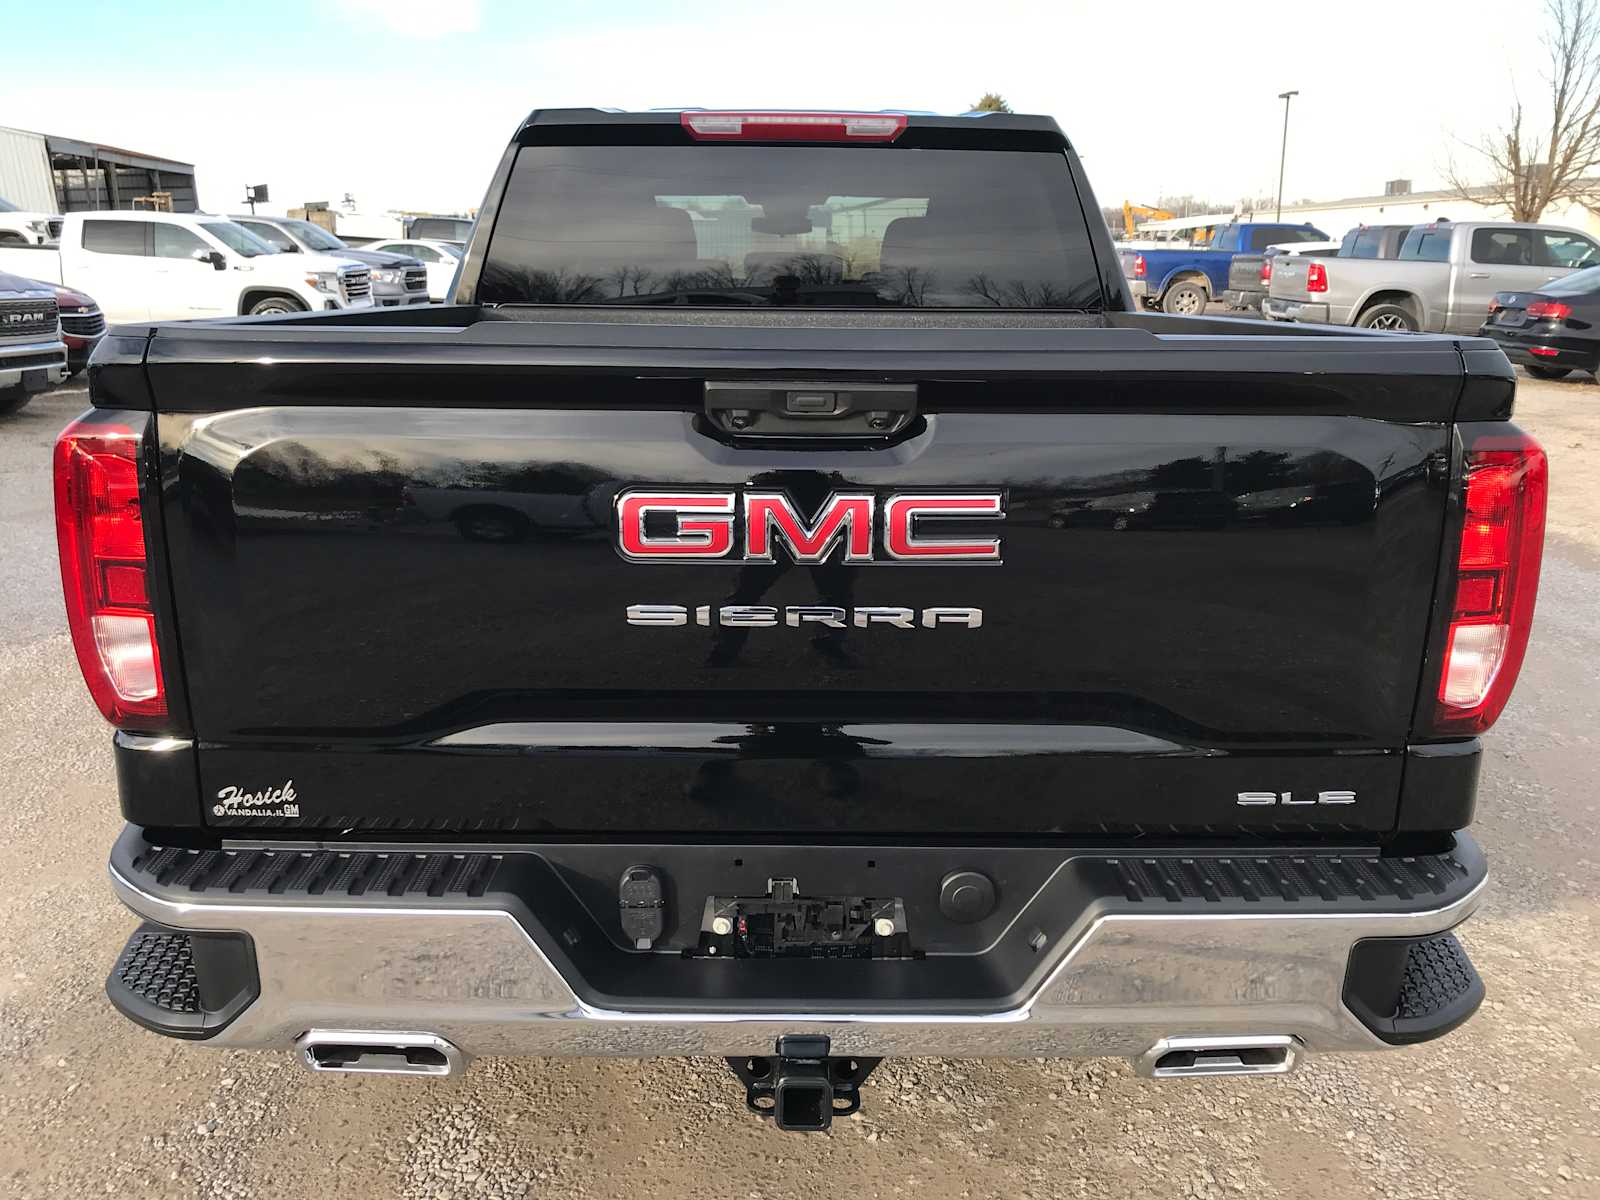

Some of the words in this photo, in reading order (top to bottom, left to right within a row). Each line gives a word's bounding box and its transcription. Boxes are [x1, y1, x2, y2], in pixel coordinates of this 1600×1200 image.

[9, 312, 44, 322] RAM
[615, 490, 1006, 565] GMC
[625, 604, 983, 629] SIERRA
[218, 780, 297, 809] Hosick
[1236, 790, 1357, 805] SLE
[283, 804, 299, 817] GM
